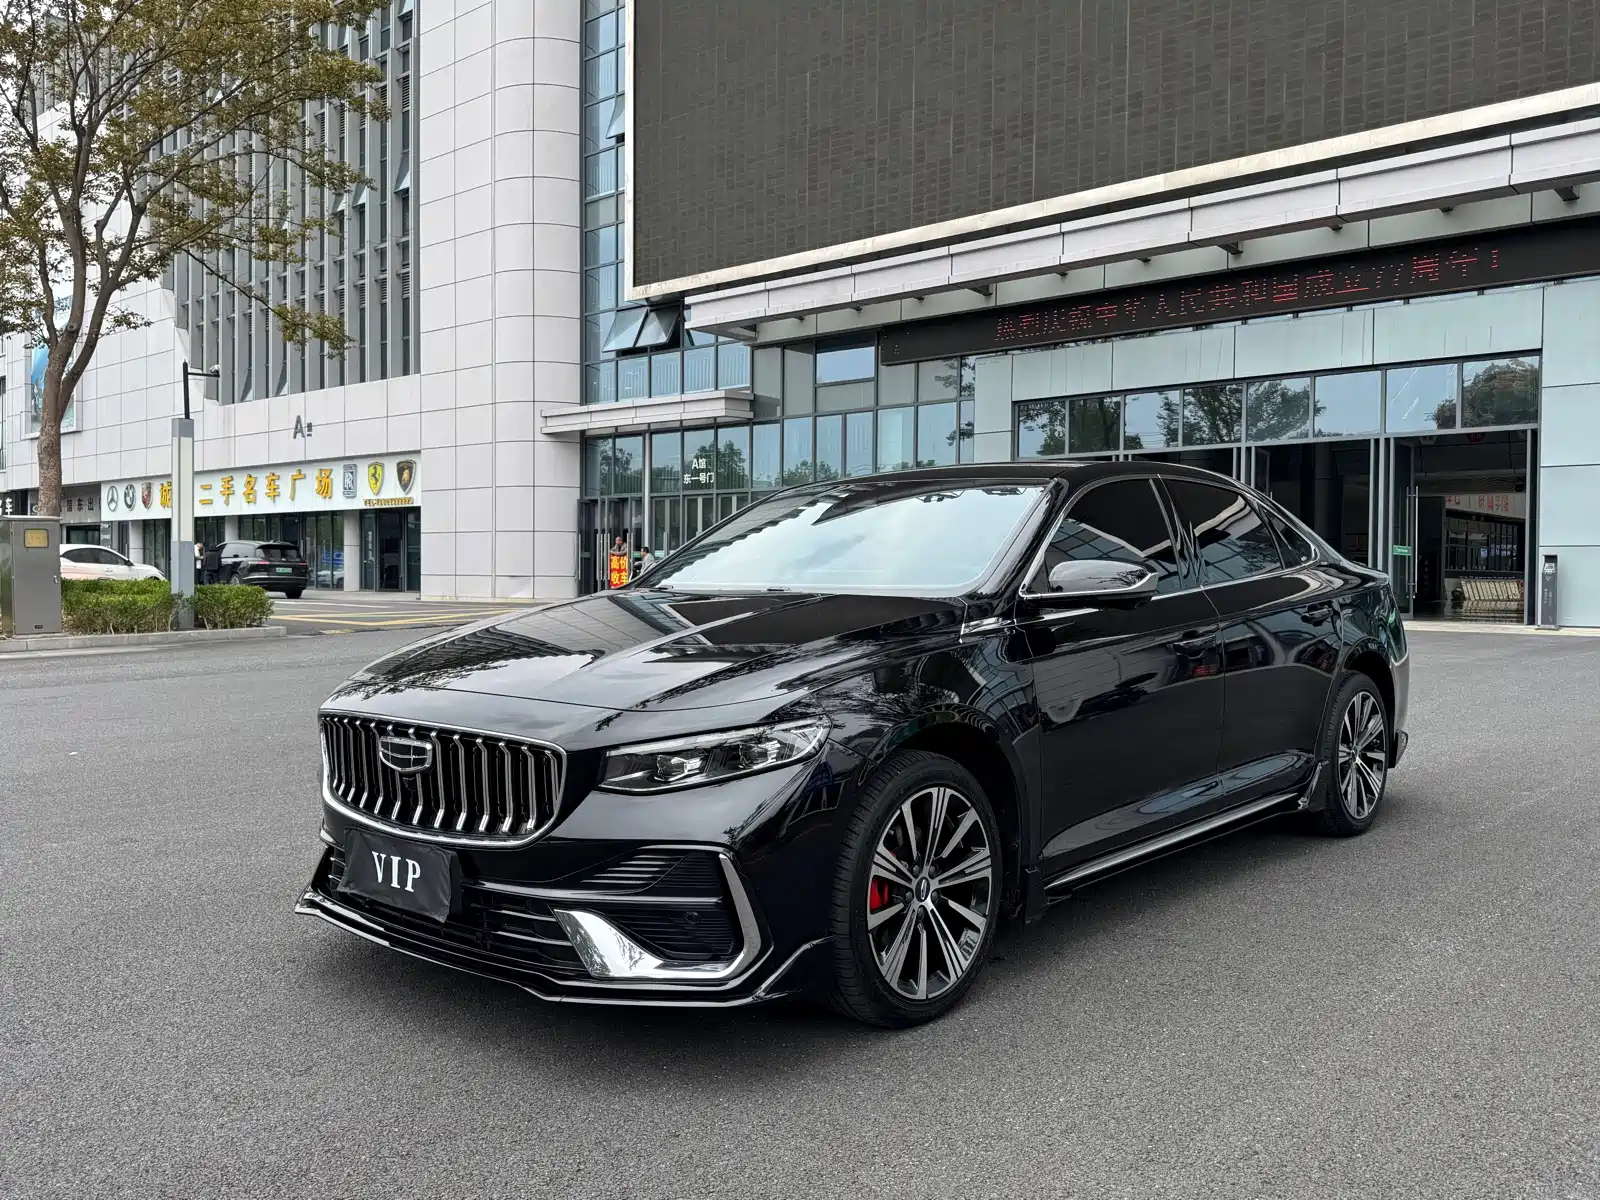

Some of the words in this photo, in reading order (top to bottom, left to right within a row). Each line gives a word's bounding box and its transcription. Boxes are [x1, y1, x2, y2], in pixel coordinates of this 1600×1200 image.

[691, 458, 706, 469] A馆
[683, 472, 715, 484] 东一号门
[611, 556, 627, 569] 高价
[611, 571, 628, 585] 收车
[371, 851, 421, 892] VIP
